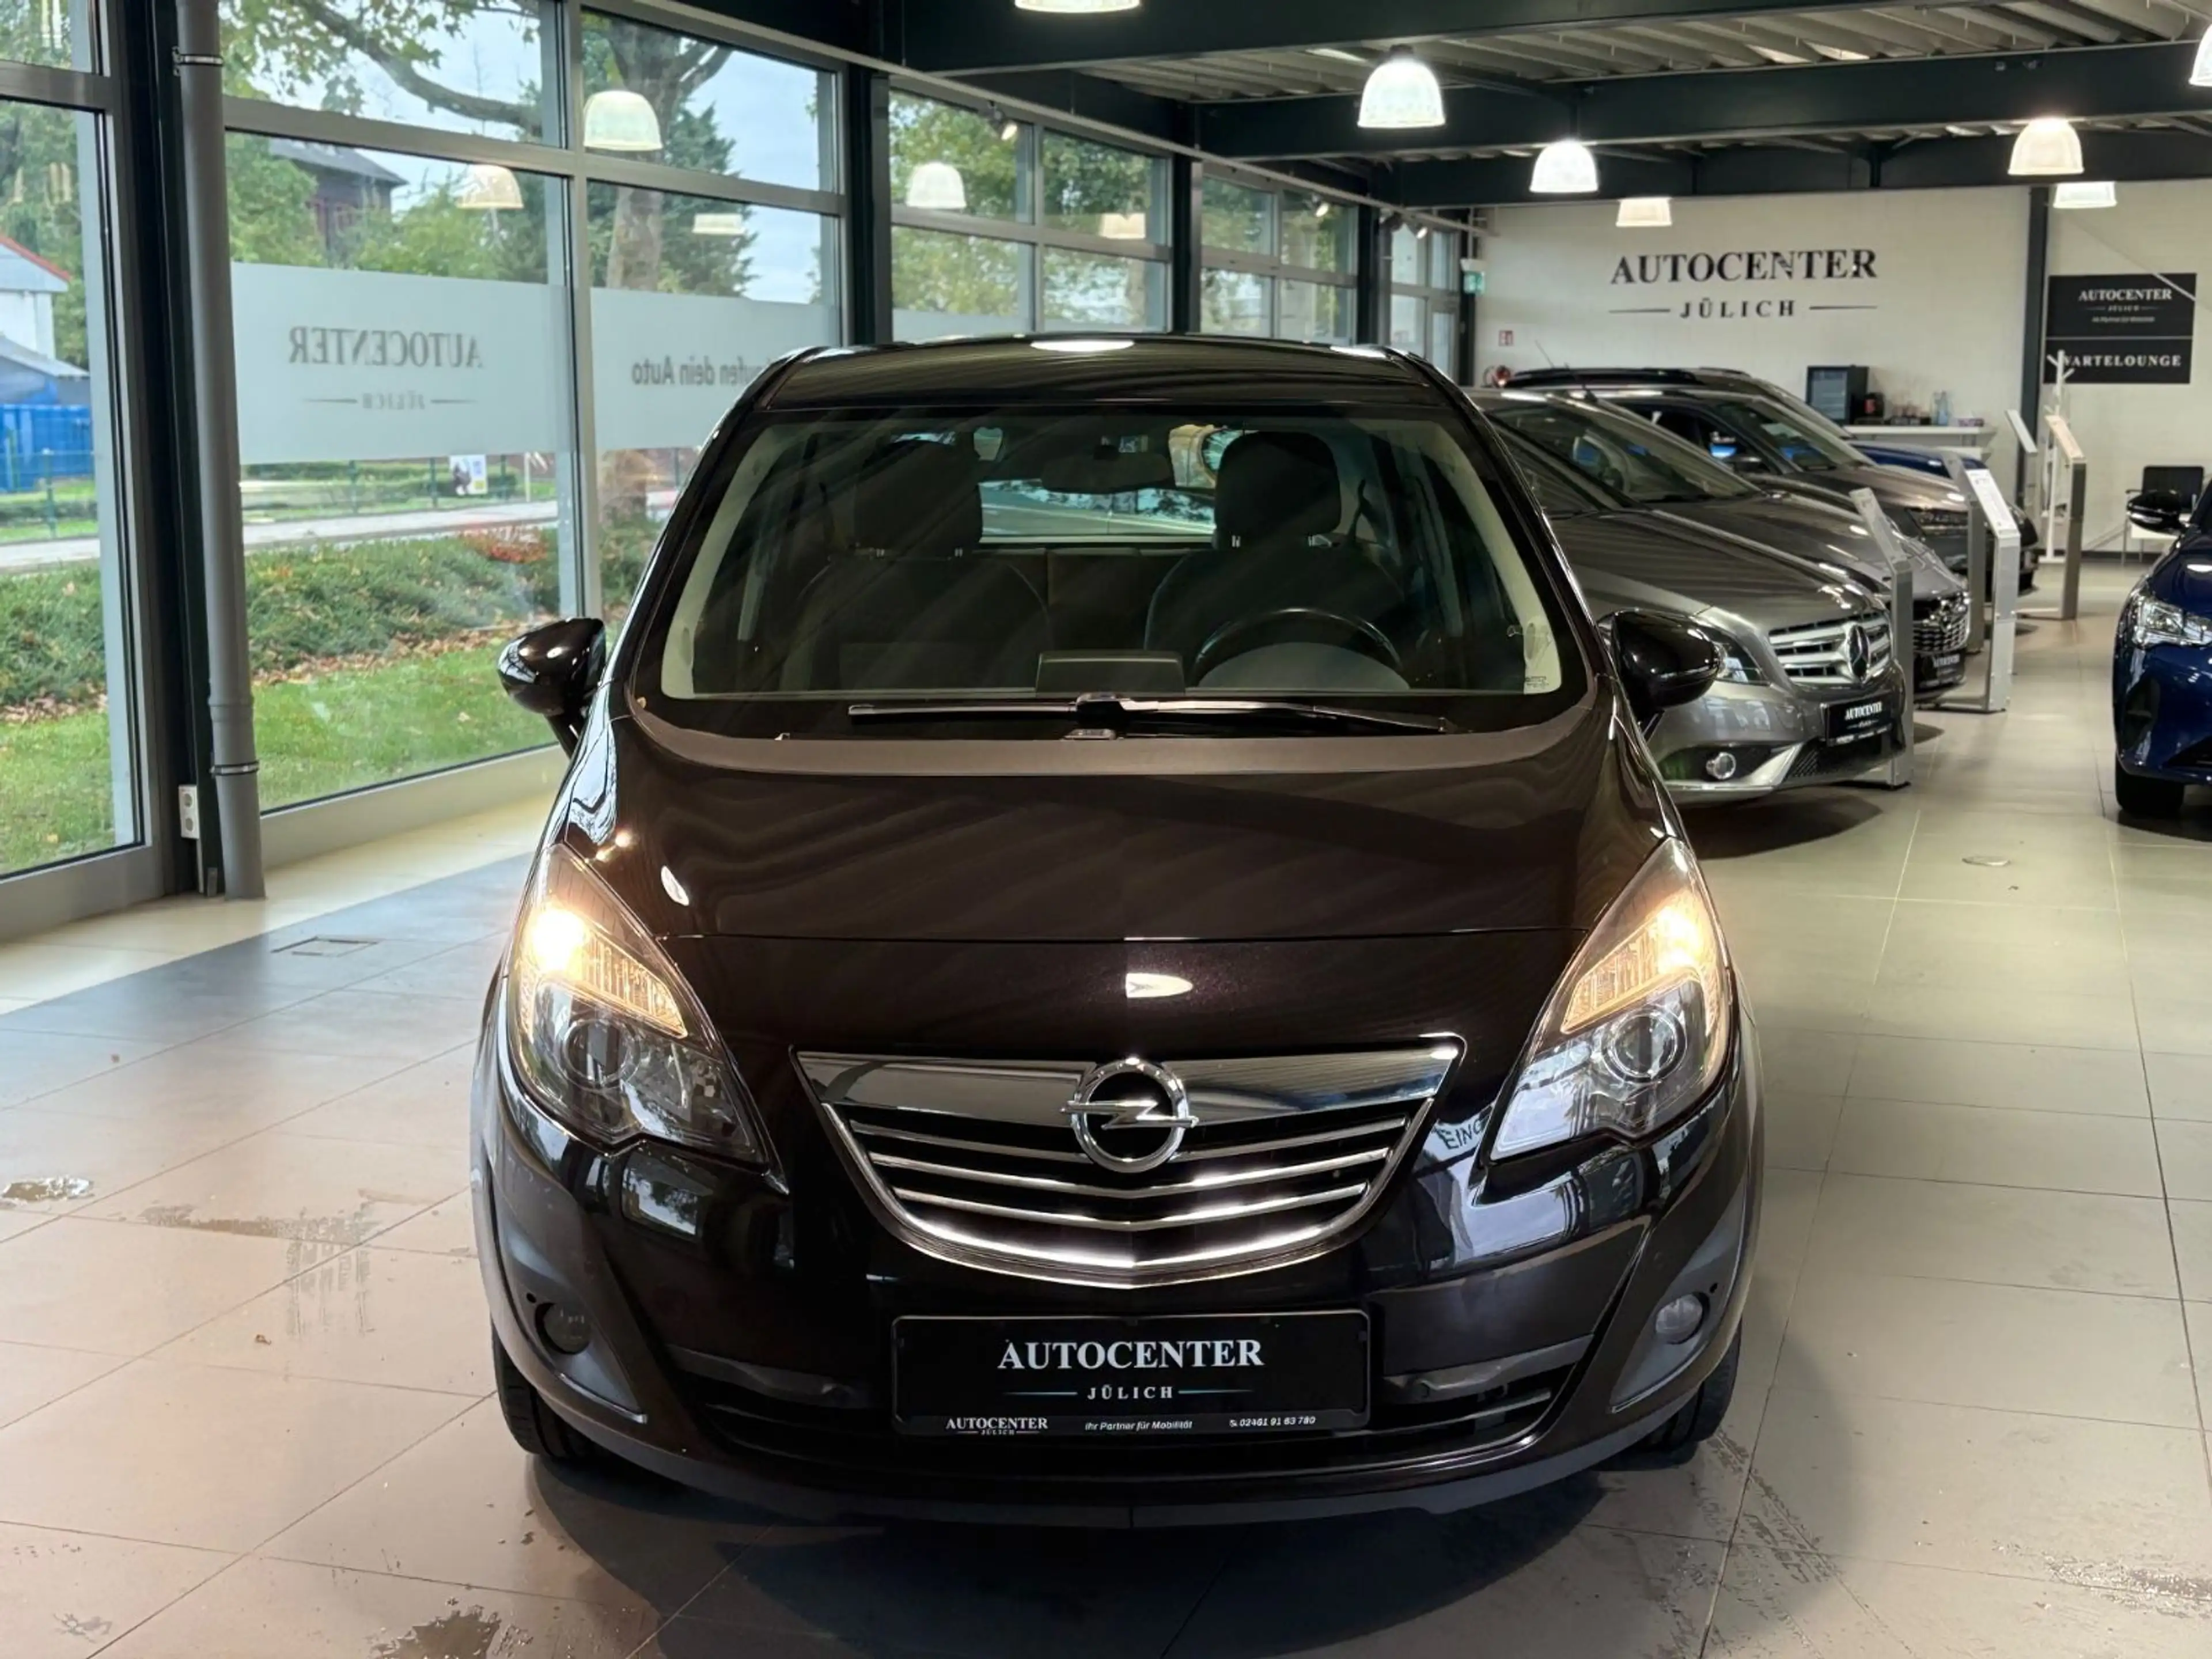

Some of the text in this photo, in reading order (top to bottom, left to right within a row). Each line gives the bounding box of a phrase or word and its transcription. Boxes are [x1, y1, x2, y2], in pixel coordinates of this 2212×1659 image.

[1611, 249, 1878, 285] AUTOCENTER
[2078, 289, 2172, 301] AUTOCENTER
[1680, 298, 1796, 319] JÜLICH
[997, 1339, 1266, 1369] AUTOCENTER
[1088, 1384, 1173, 1400] JÜLICH
[946, 1417, 1048, 1429] AUTOCENTER
[1100, 1422, 1135, 1430] Partner
[1136, 1421, 1150, 1431] für
